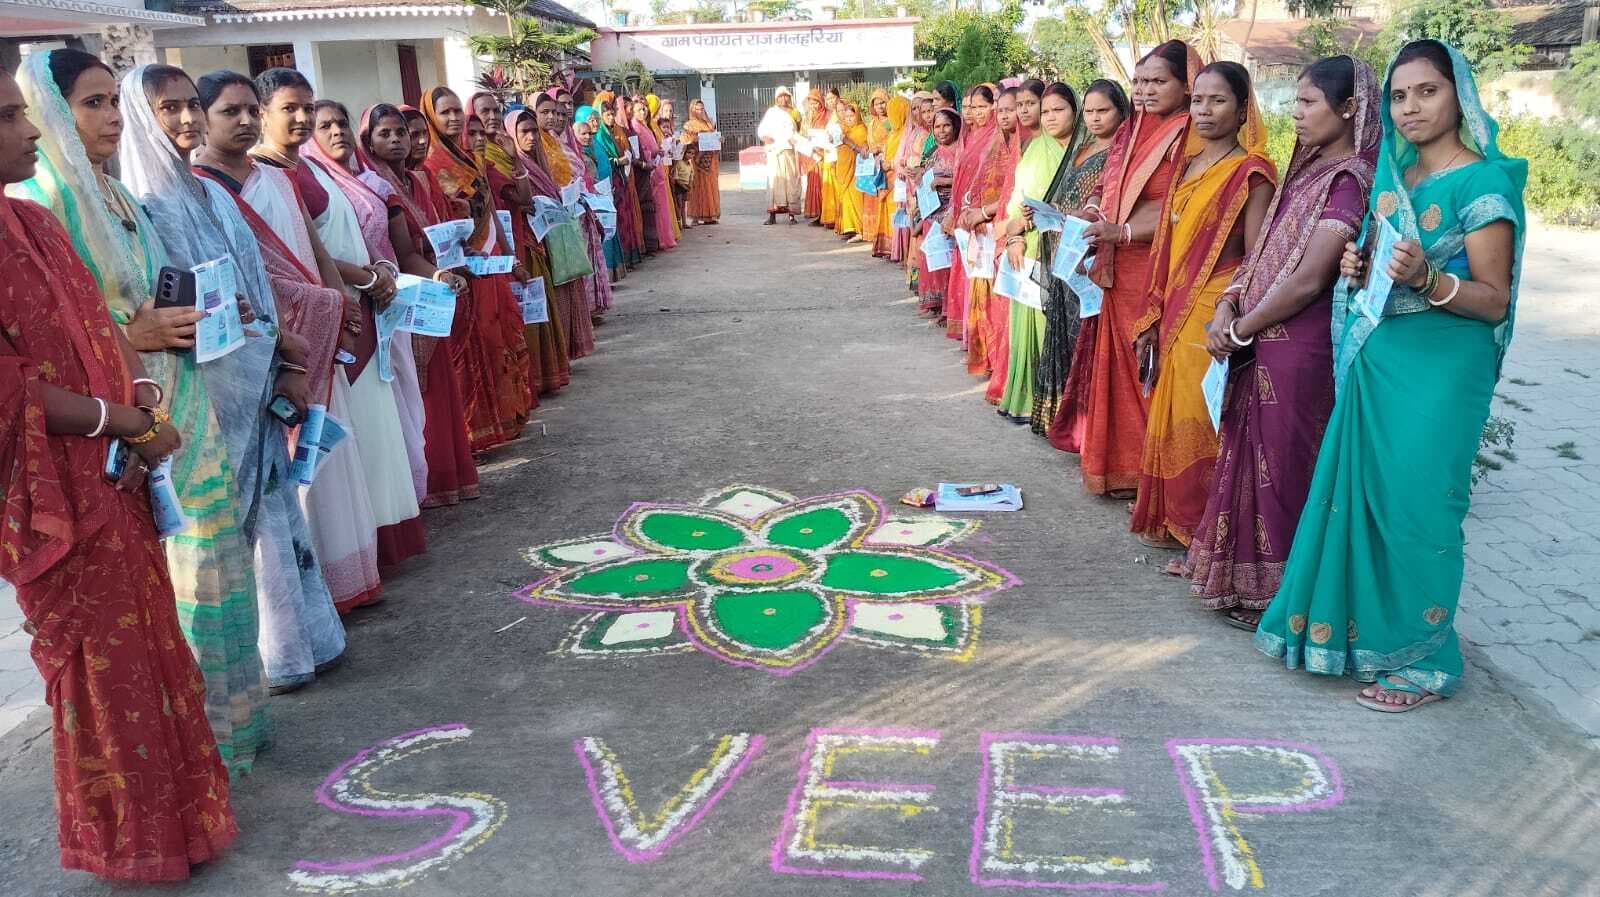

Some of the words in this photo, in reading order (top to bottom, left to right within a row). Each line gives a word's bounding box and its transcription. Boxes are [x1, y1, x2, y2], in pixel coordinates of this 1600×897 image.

[661, 34, 690, 48] ग्राम
[692, 33, 742, 47] पंचायत
[746, 33, 772, 46] राज
[287, 722, 1345, 893] SVEEP
